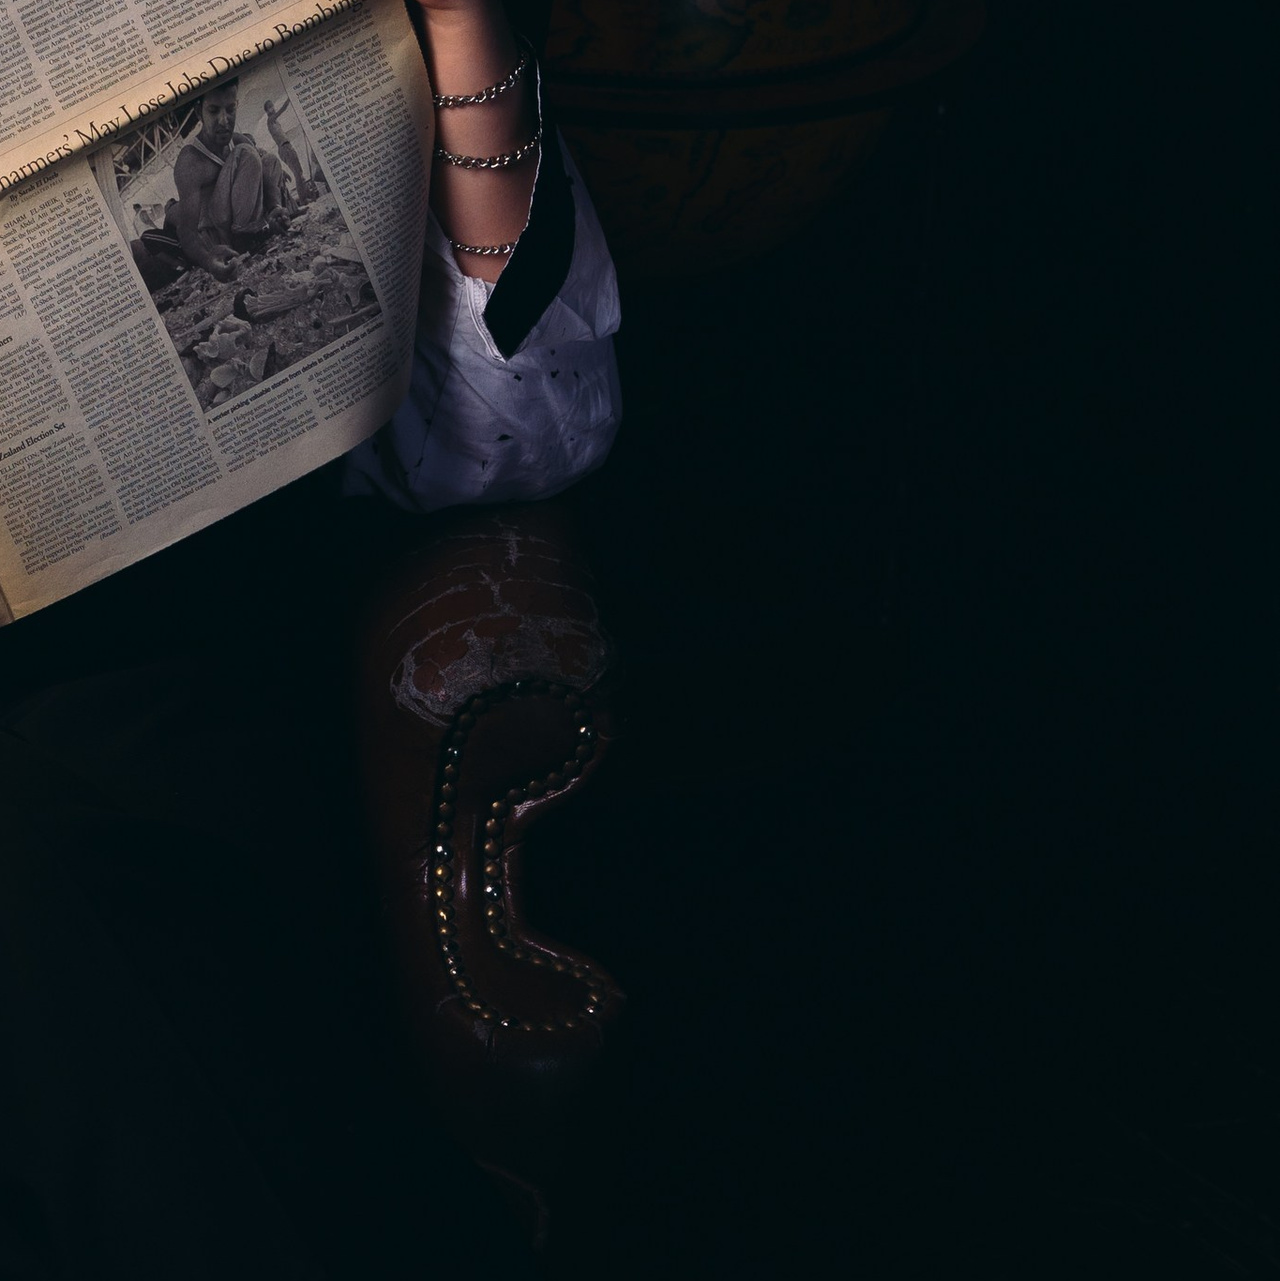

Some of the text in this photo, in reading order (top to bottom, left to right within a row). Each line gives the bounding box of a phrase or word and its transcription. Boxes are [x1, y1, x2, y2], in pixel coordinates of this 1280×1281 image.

[72, 116, 120, 146] May
[118, 93, 166, 122] Lose
[163, 70, 209, 98] Jobs
[206, 48, 252, 75] Due
[253, 37, 275, 52] to
[2, 213, 27, 231] SHARM
[211, 408, 231, 423] worker
[229, 397, 251, 414] picking
[270, 376, 290, 391] stones
[287, 369, 303, 381] from
[300, 360, 319, 374] debris
[24, 428, 55, 448] Election
[52, 421, 67, 433] Set
